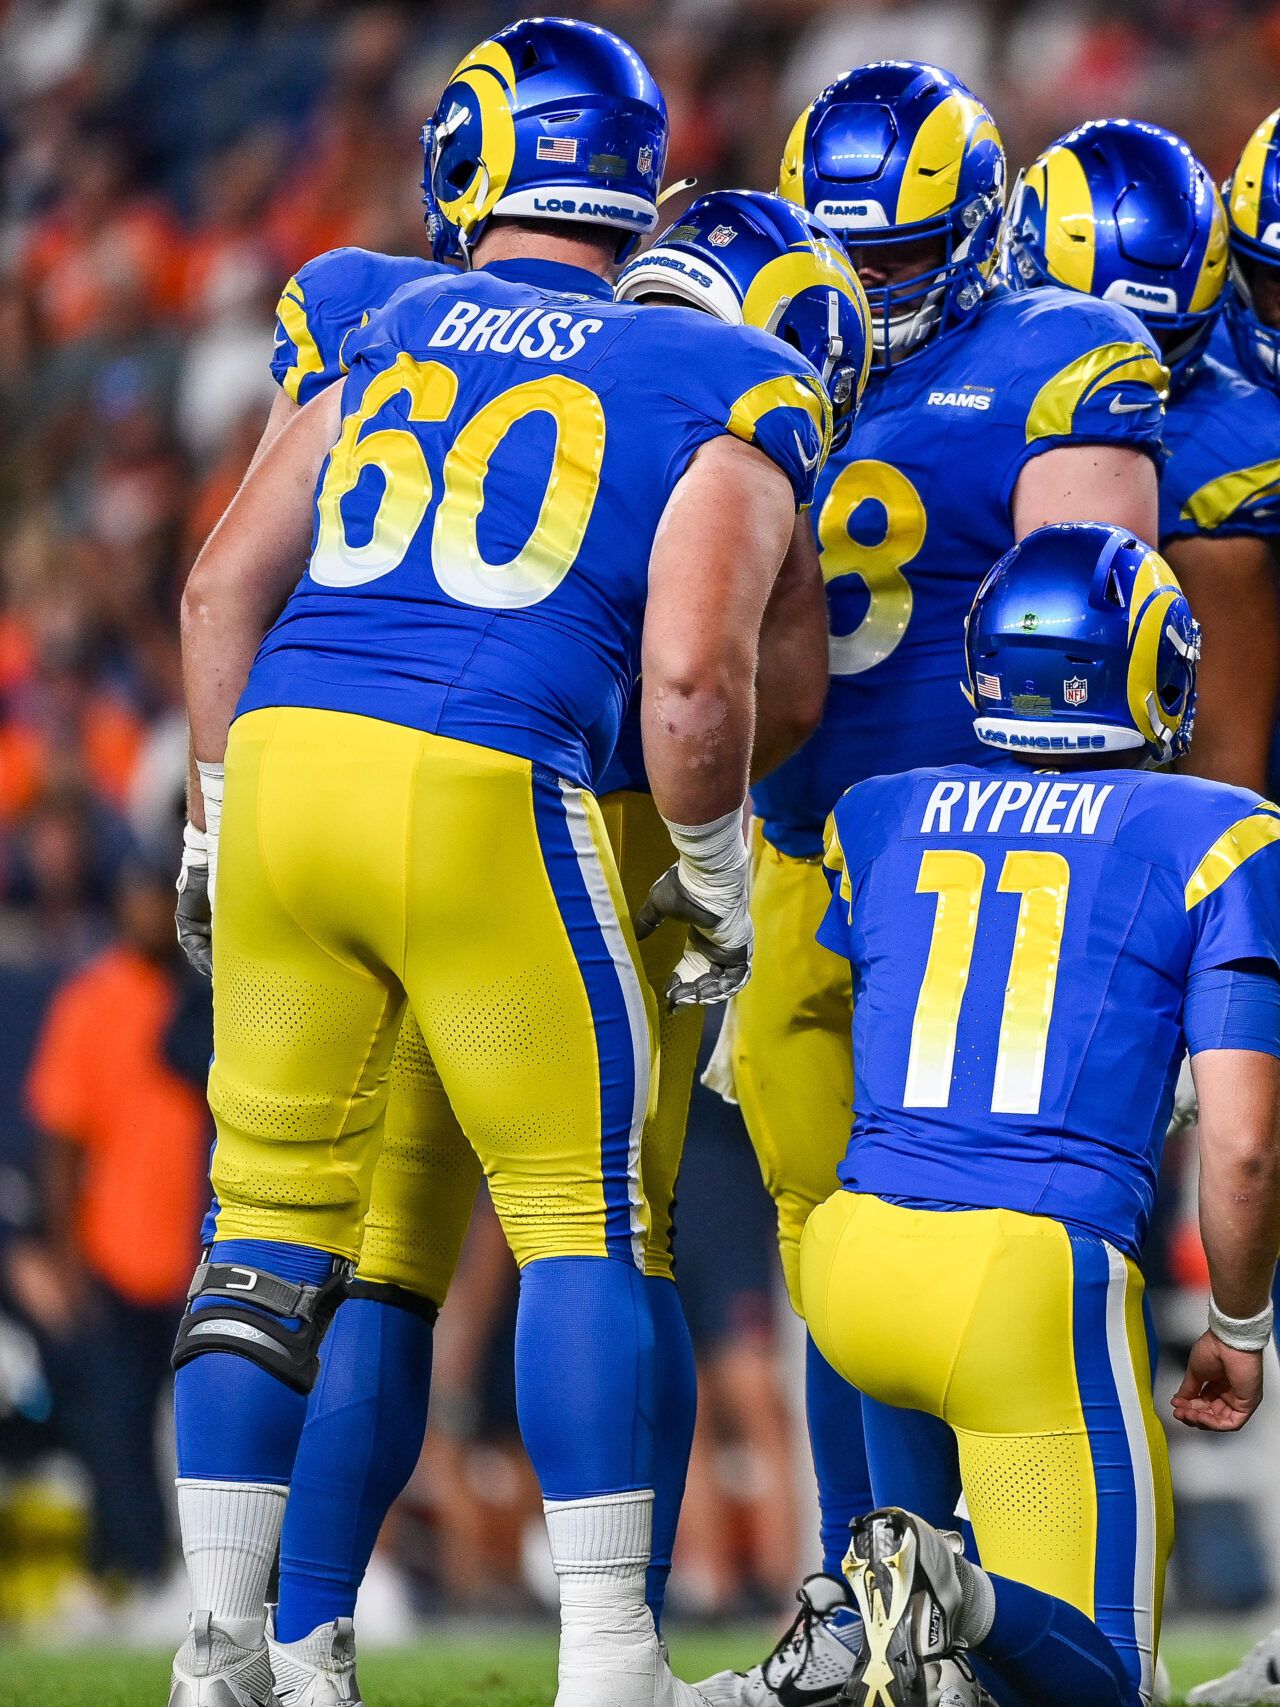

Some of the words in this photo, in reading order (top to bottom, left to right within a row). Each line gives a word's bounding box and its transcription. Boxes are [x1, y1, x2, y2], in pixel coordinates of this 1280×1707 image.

[533, 198, 576, 213] LOS
[578, 202, 654, 226] ANGELES
[823, 205, 868, 216] RAMS
[710, 231, 727, 244] NFL
[640, 256, 714, 289] ANGELES
[428, 301, 604, 361] BRUSS
[927, 392, 992, 411] RAMS
[309, 352, 607, 609] 60
[1067, 689, 1085, 702] NFL
[977, 727, 1007, 745] LOS
[1008, 734, 1106, 751] ANGELES
[920, 781, 1115, 835] RYPIEN
[903, 850, 1071, 1115] 11
[202, 1323, 265, 1339] DONJOY
[930, 1602, 941, 1646] ALPHA
